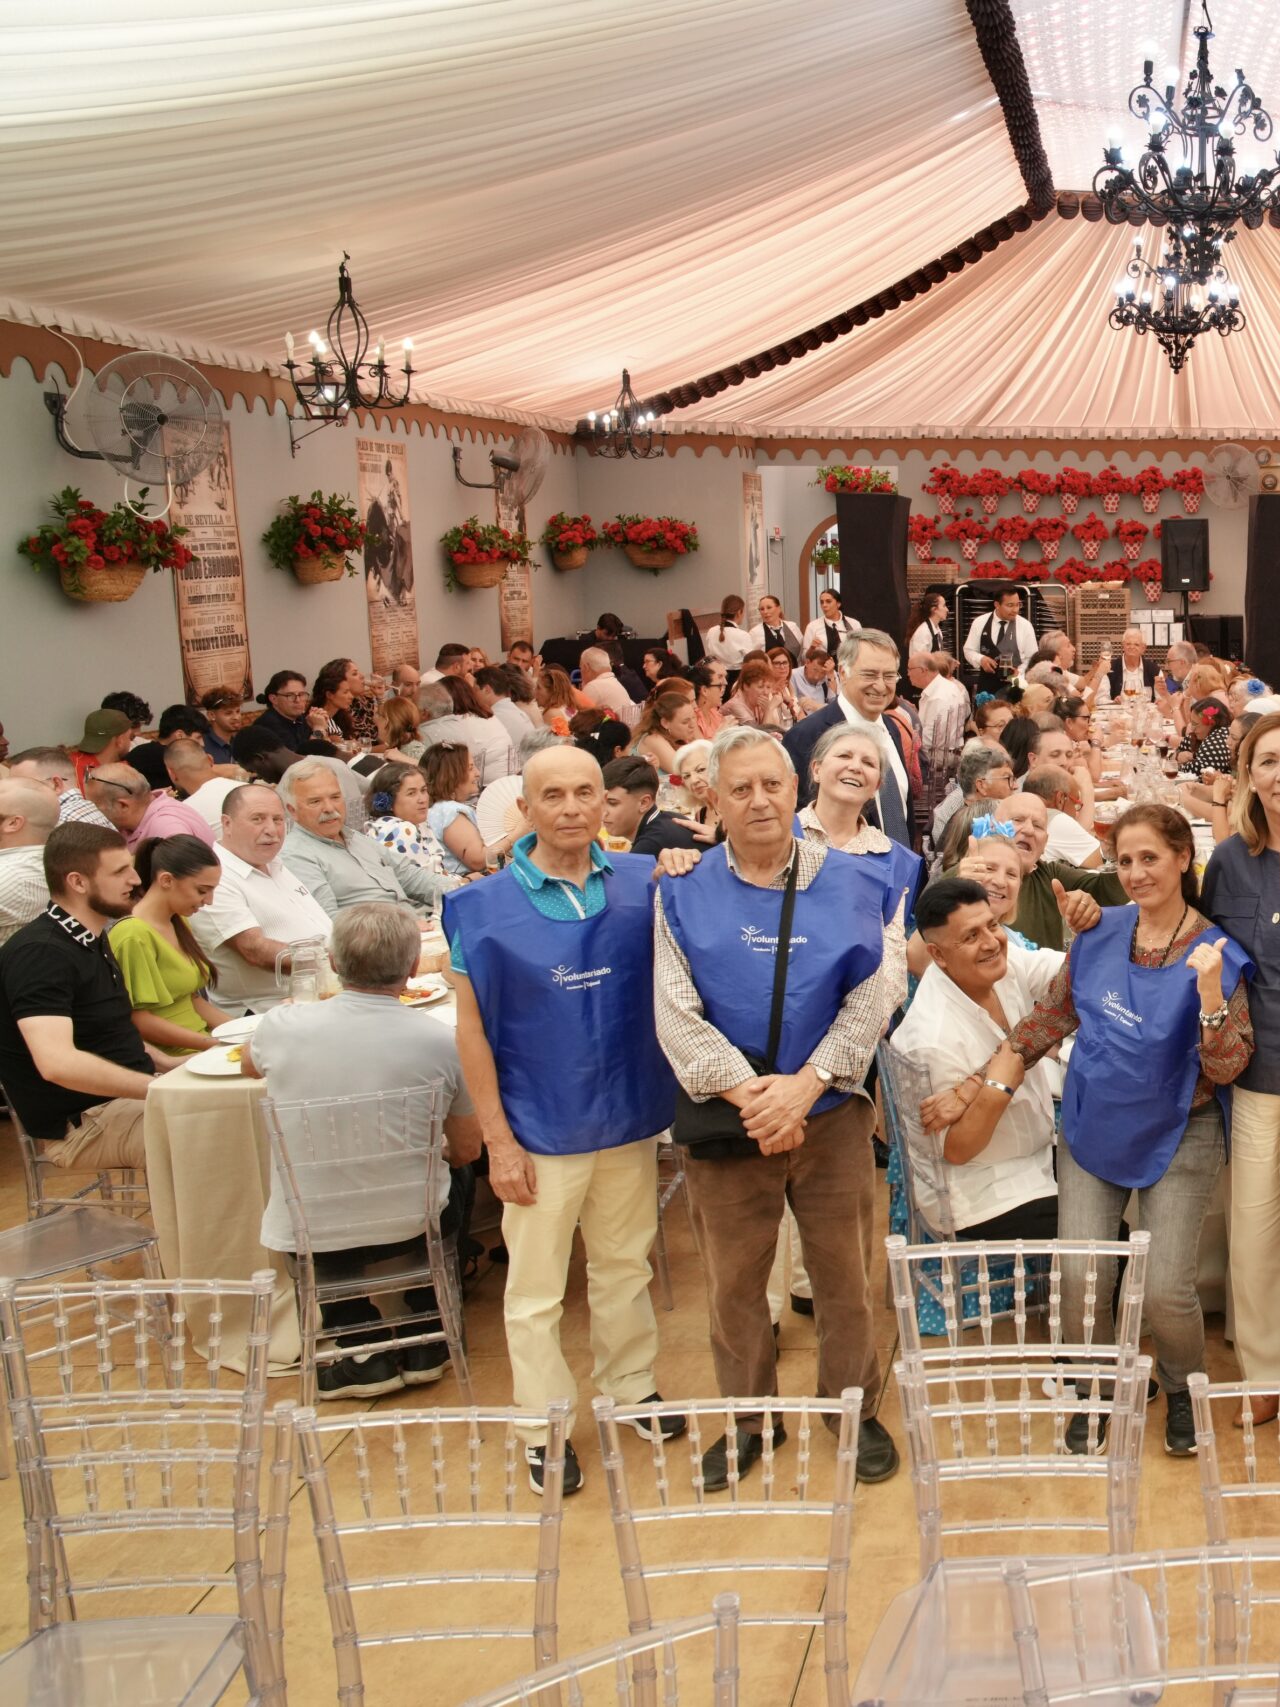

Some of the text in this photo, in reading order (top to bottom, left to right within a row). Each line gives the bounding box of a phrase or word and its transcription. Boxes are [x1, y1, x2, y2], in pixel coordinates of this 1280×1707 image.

[194, 514, 224, 525] SEVILLA
[47, 903, 96, 947] LER
[751, 935, 809, 945] voluntado
[562, 966, 612, 982] voluntariado
